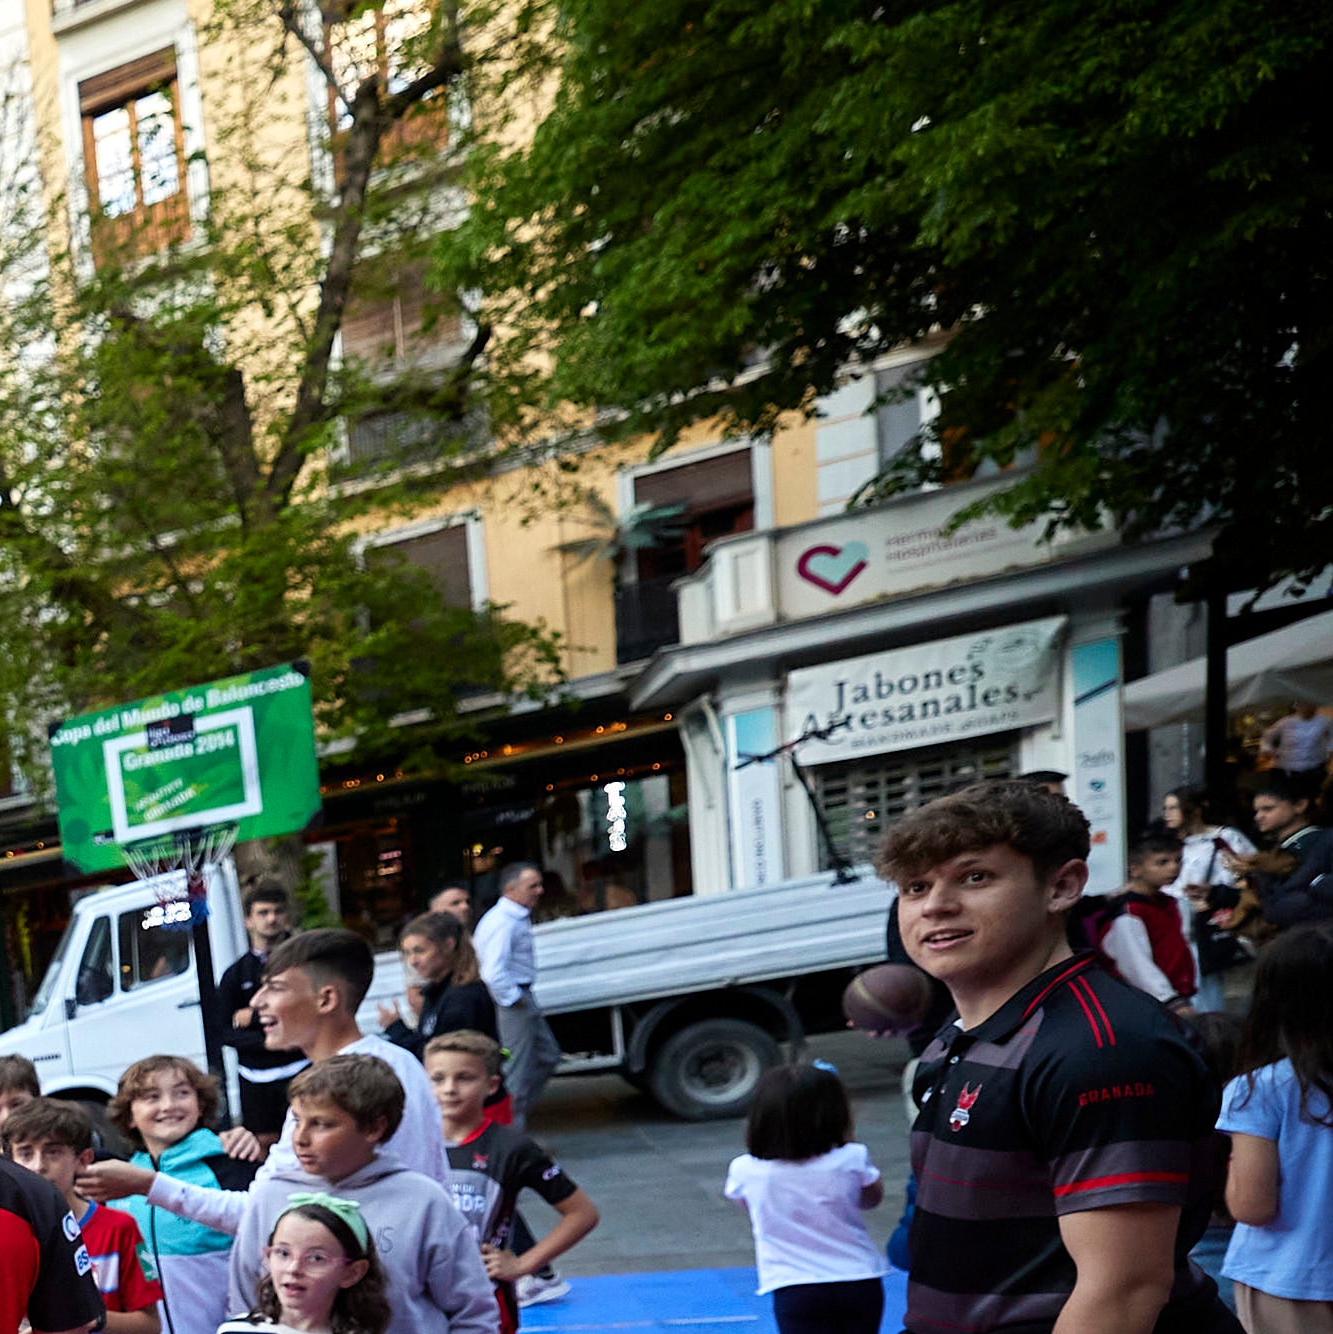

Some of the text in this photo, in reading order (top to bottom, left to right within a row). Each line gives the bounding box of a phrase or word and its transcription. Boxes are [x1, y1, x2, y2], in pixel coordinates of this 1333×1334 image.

[835, 659, 986, 715] Jabones
[121, 701, 181, 730] Mundo
[123, 743, 194, 771] Granada
[1078, 1082, 1156, 1107] GRANADA
